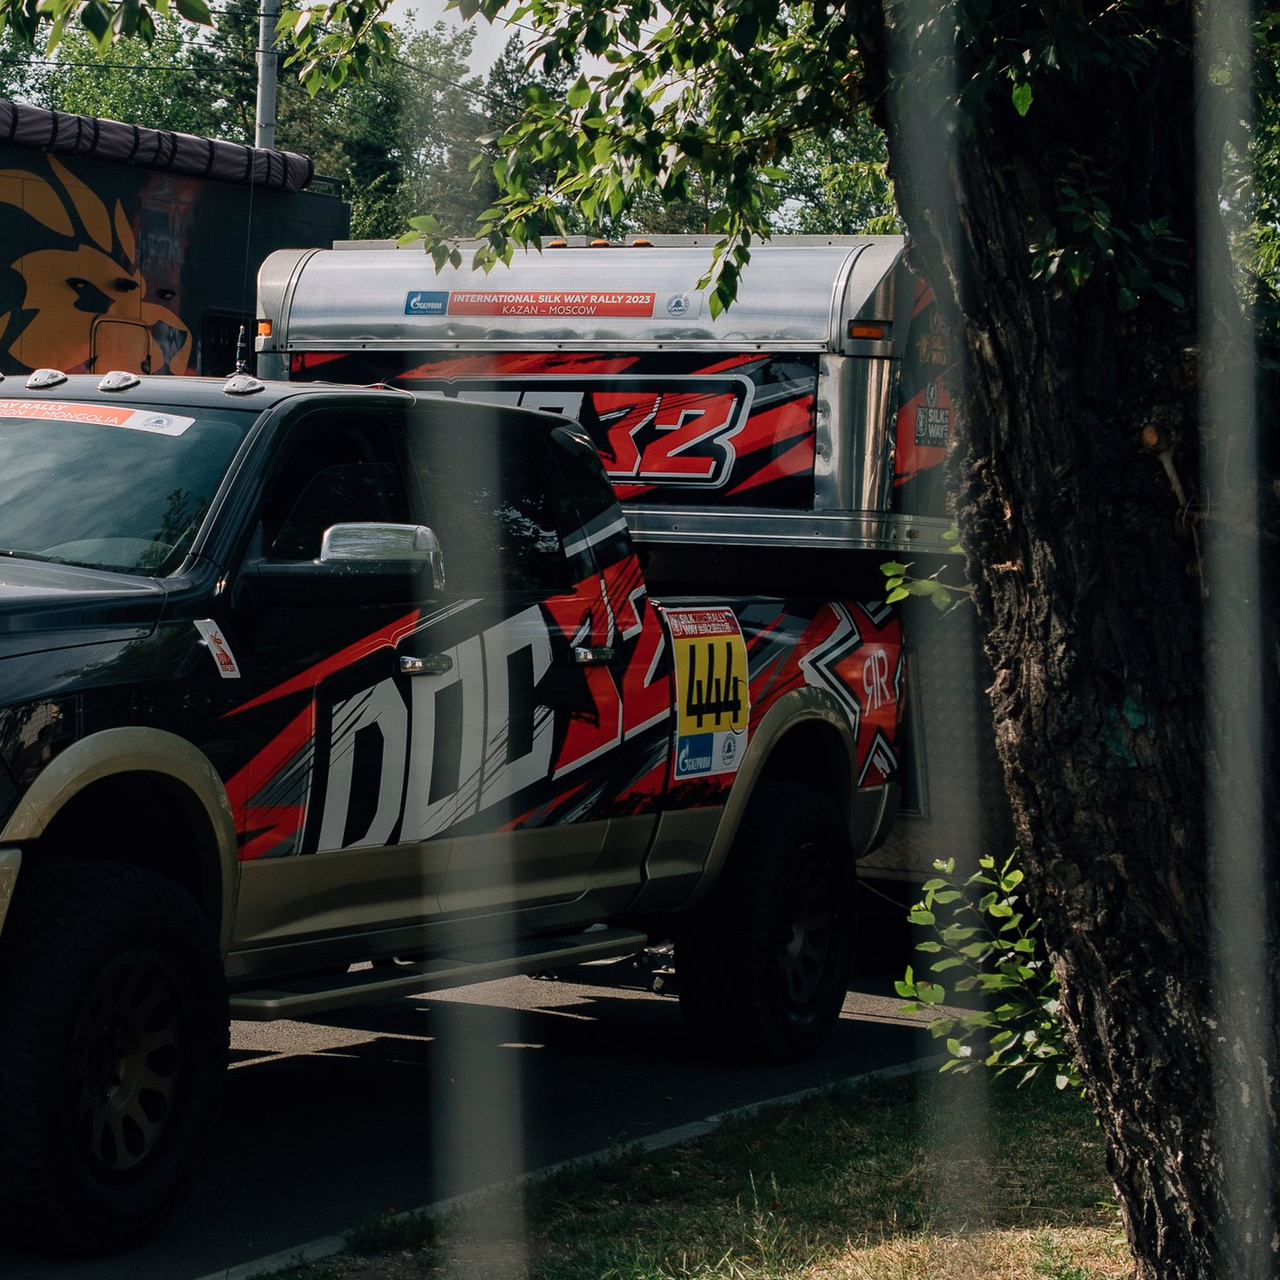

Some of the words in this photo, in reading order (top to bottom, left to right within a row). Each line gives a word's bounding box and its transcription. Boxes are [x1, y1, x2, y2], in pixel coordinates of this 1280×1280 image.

[453, 294, 538, 304] INTERNATIONAL
[539, 295, 563, 304] SILK
[565, 295, 590, 304] WAY
[591, 295, 624, 304] RALLY
[626, 295, 651, 304] 2023
[502, 305, 538, 314] KAZAN
[549, 306, 597, 315] MOSCOW
[22, 403, 68, 411] RALLY
[41, 411, 119, 425] MONGOLIA
[678, 613, 696, 624] SILK
[706, 612, 727, 623] RALLY
[682, 623, 699, 635] WAY
[686, 642, 741, 728] 444
